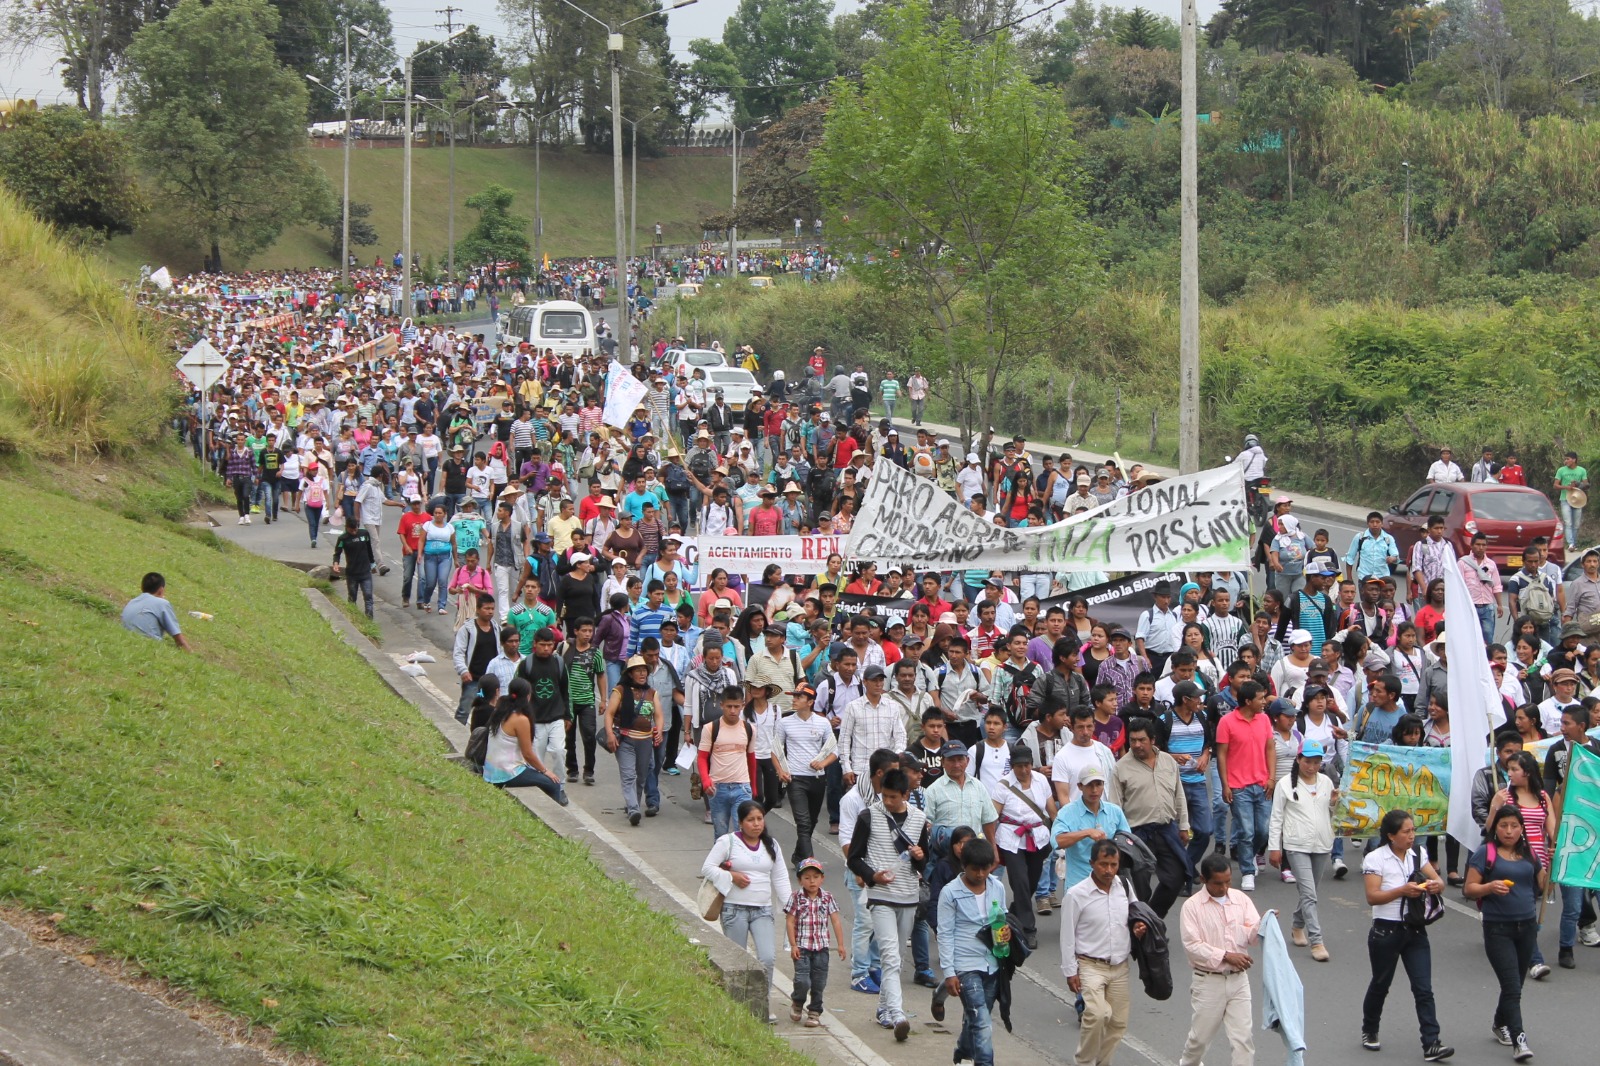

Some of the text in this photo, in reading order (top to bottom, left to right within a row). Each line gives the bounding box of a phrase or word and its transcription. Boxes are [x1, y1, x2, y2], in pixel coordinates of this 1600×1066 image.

[870, 458, 935, 521] PARO
[708, 546, 792, 559] ACENTAMIENTO
[1350, 759, 1434, 798] ZONA
